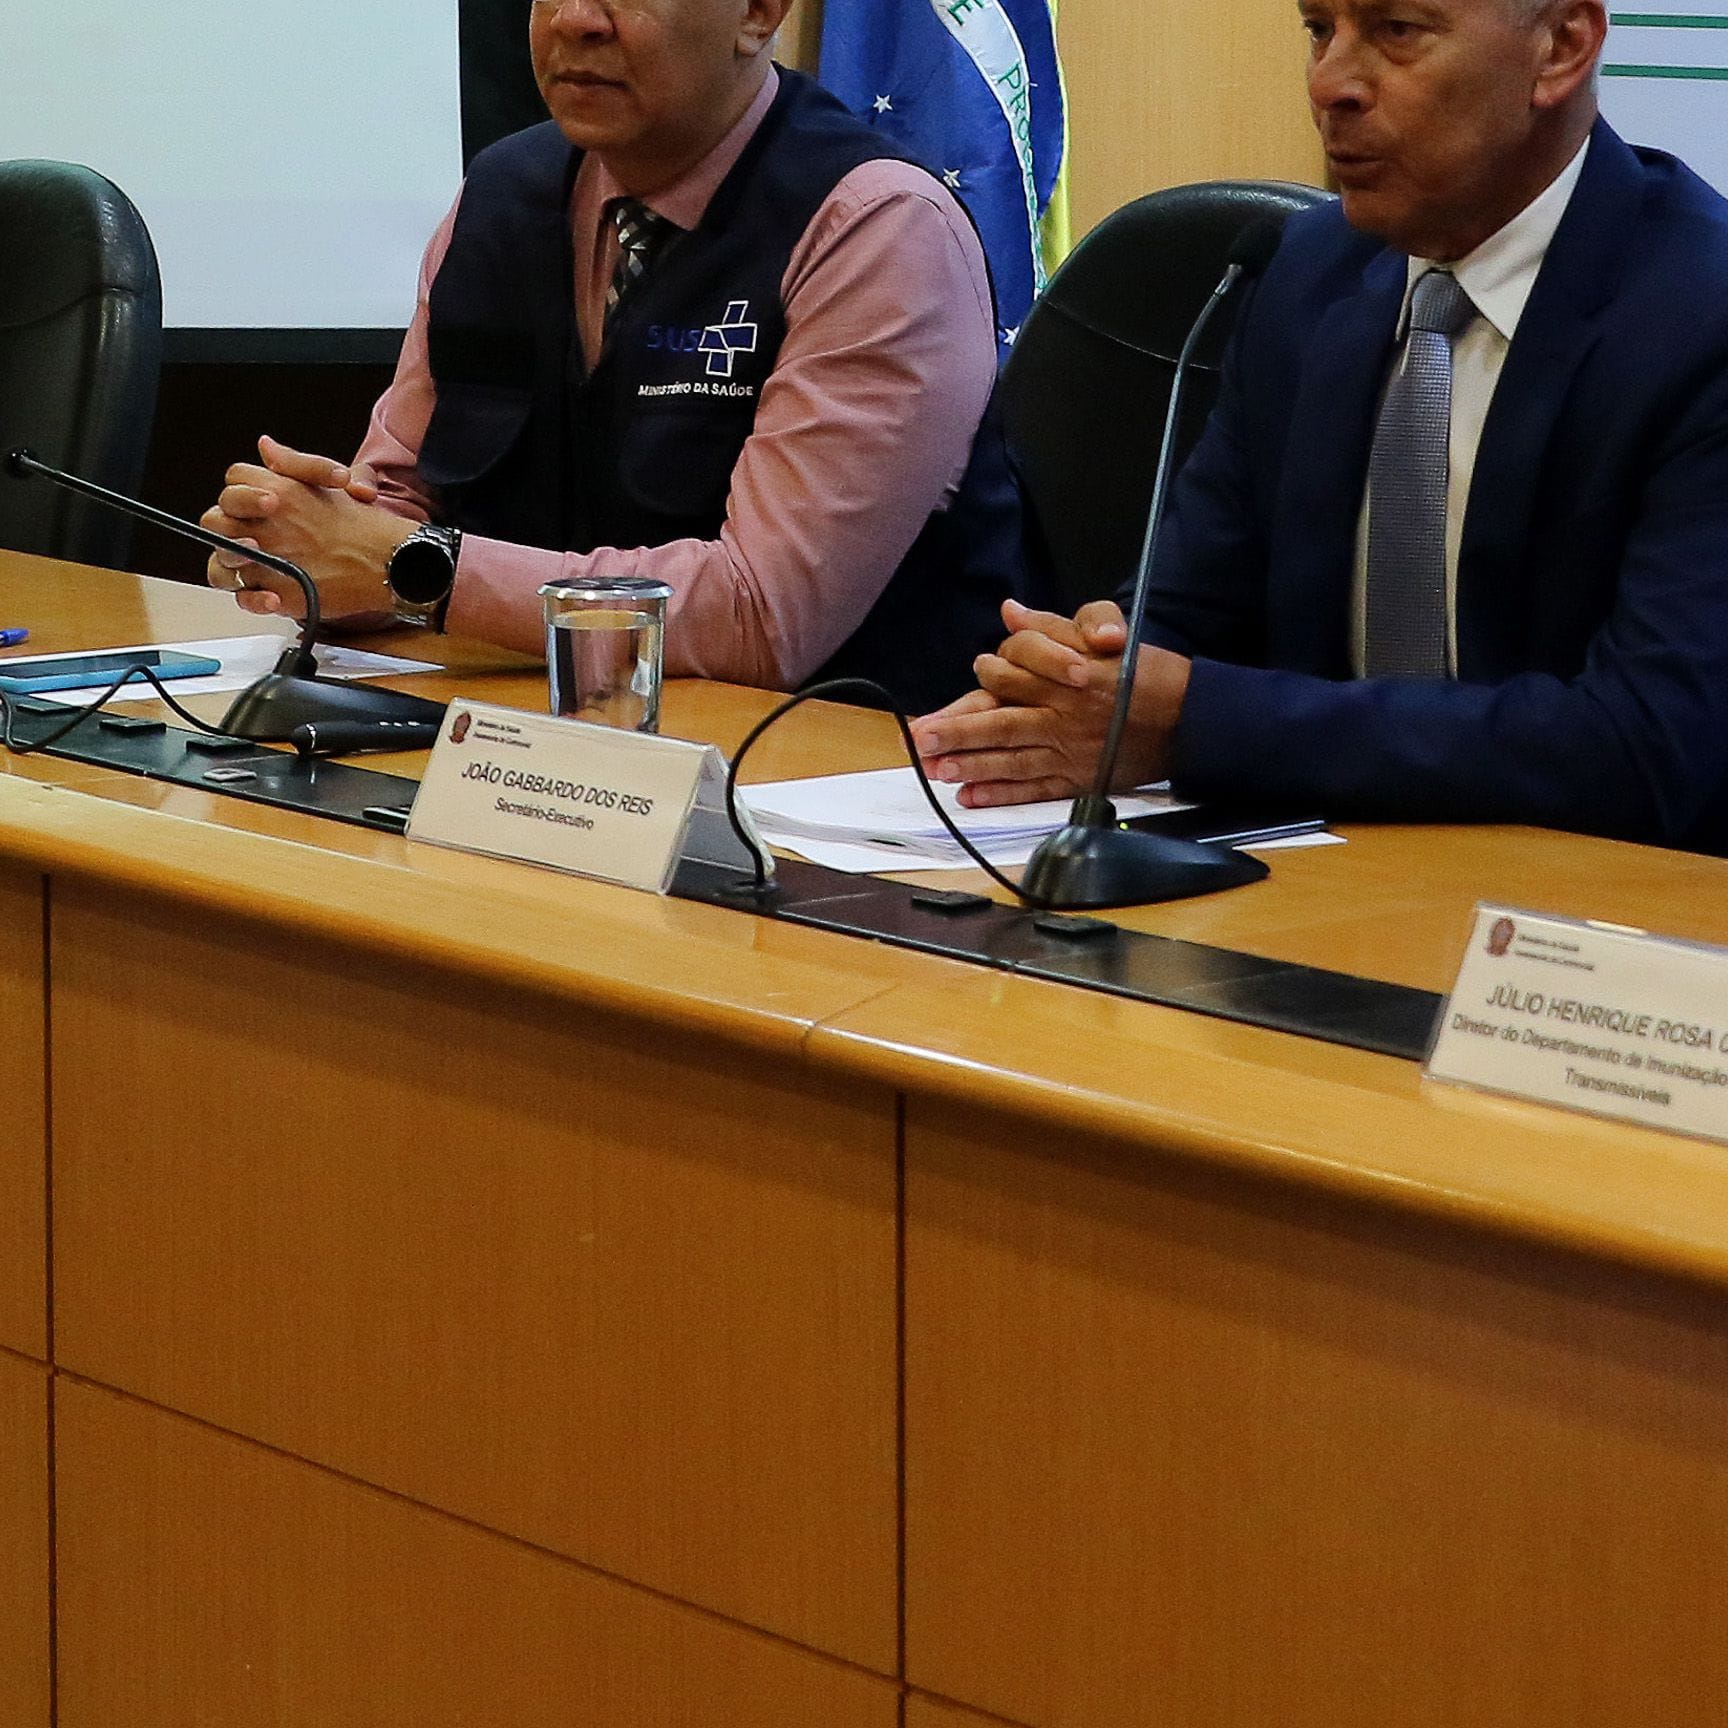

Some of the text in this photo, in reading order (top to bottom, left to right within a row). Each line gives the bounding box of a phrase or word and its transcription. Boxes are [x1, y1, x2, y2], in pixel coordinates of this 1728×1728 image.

[647, 324, 701, 352] SUS
[693, 382, 709, 395] DA
[710, 382, 754, 396] SAÚDE
[461, 761, 654, 816] JOÃO GABBARDO DOS REIS
[1485, 982, 1544, 1015] JÚLIO
[1546, 997, 1652, 1037] HENRIQUE
[1654, 1020, 1712, 1049] ROSA
[1501, 1026, 1519, 1042] do
[1522, 1028, 1621, 1065] Departamento
